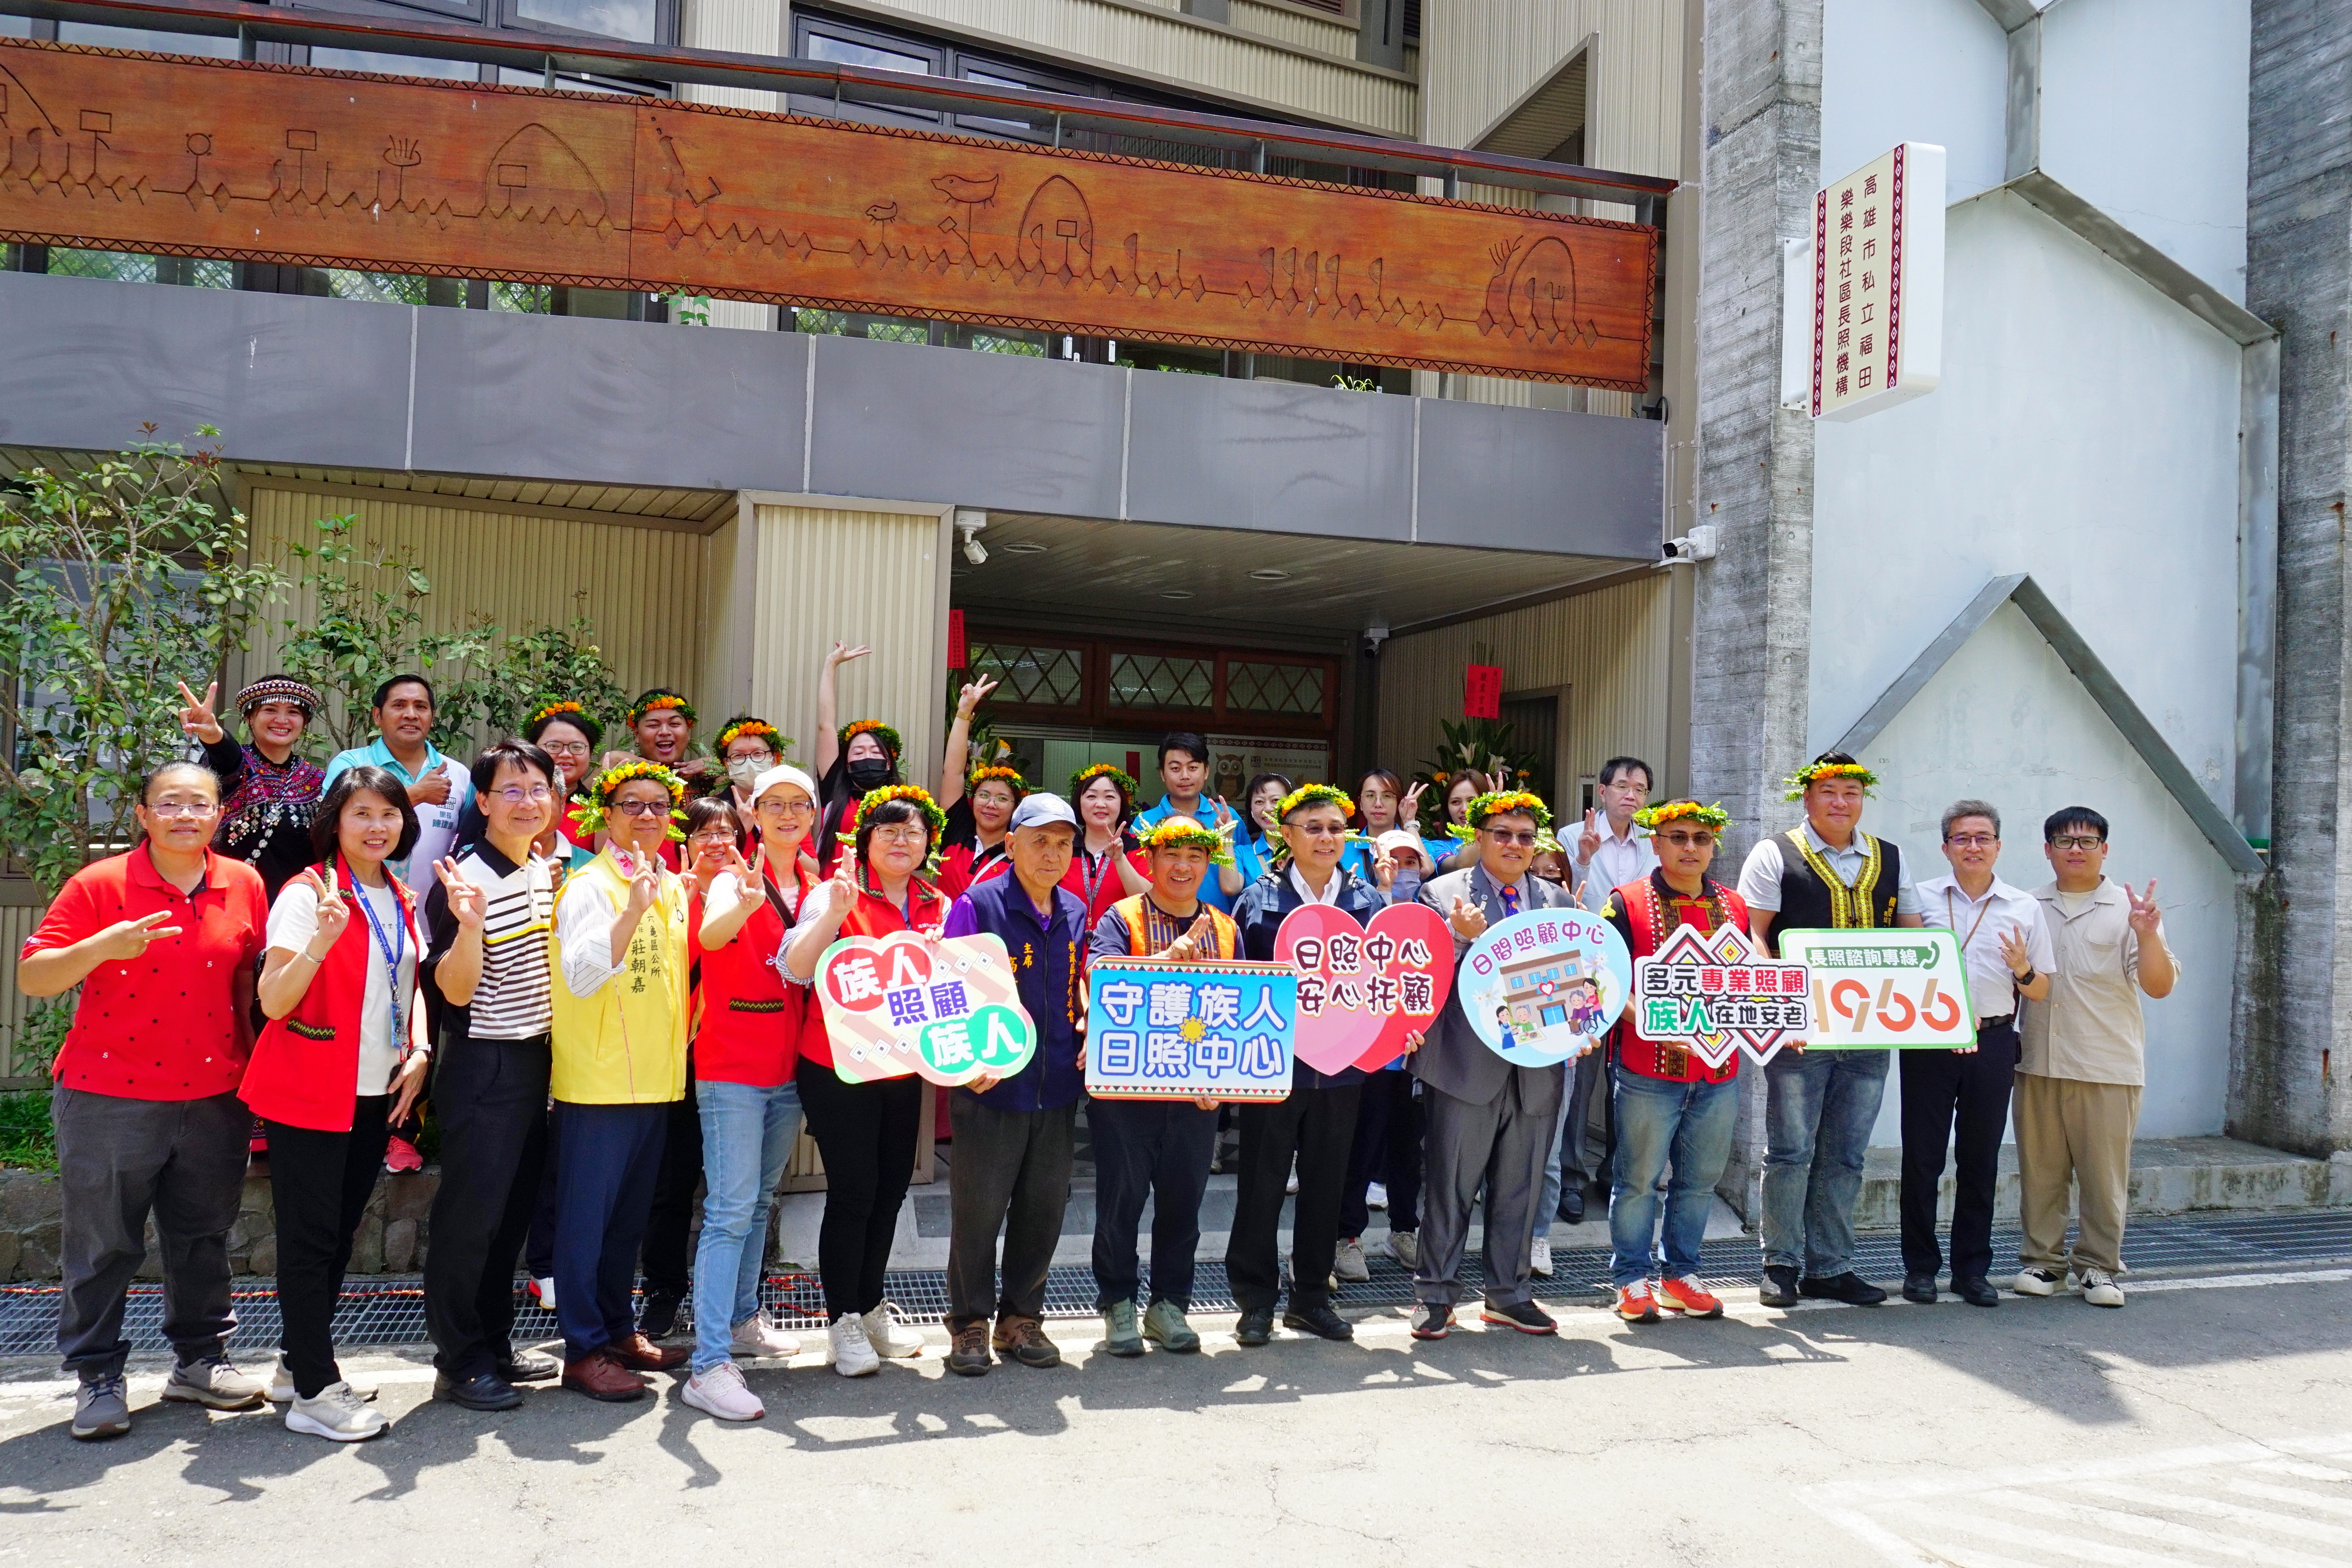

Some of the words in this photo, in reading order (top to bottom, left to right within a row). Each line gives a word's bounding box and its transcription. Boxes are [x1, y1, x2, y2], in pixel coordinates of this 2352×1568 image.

[1835, 187, 1854, 398] 樂樂段社區長照機構
[1859, 173, 1878, 389] 高雄市私立福田
[630, 938, 646, 994] 莊朝嘉
[647, 913, 661, 978] 六龜區公所
[1022, 942, 1034, 969] 主席
[1295, 934, 1429, 971] 日照中心
[1472, 920, 1605, 975] 日間照顧中心
[1809, 949, 1920, 967] 長照諮詢專線
[832, 946, 927, 1004] 族人
[1297, 976, 1432, 1014] 安心托顧
[1647, 967, 1804, 993] 多元專業照顧
[887, 980, 970, 1027] 照顧
[1100, 980, 1286, 1030] 守護族人
[1647, 1000, 1803, 1032] 族人在地安老
[1813, 978, 1961, 1032] 1966
[927, 1012, 1024, 1067] 族人
[1099, 1031, 1285, 1078] 日照中心
